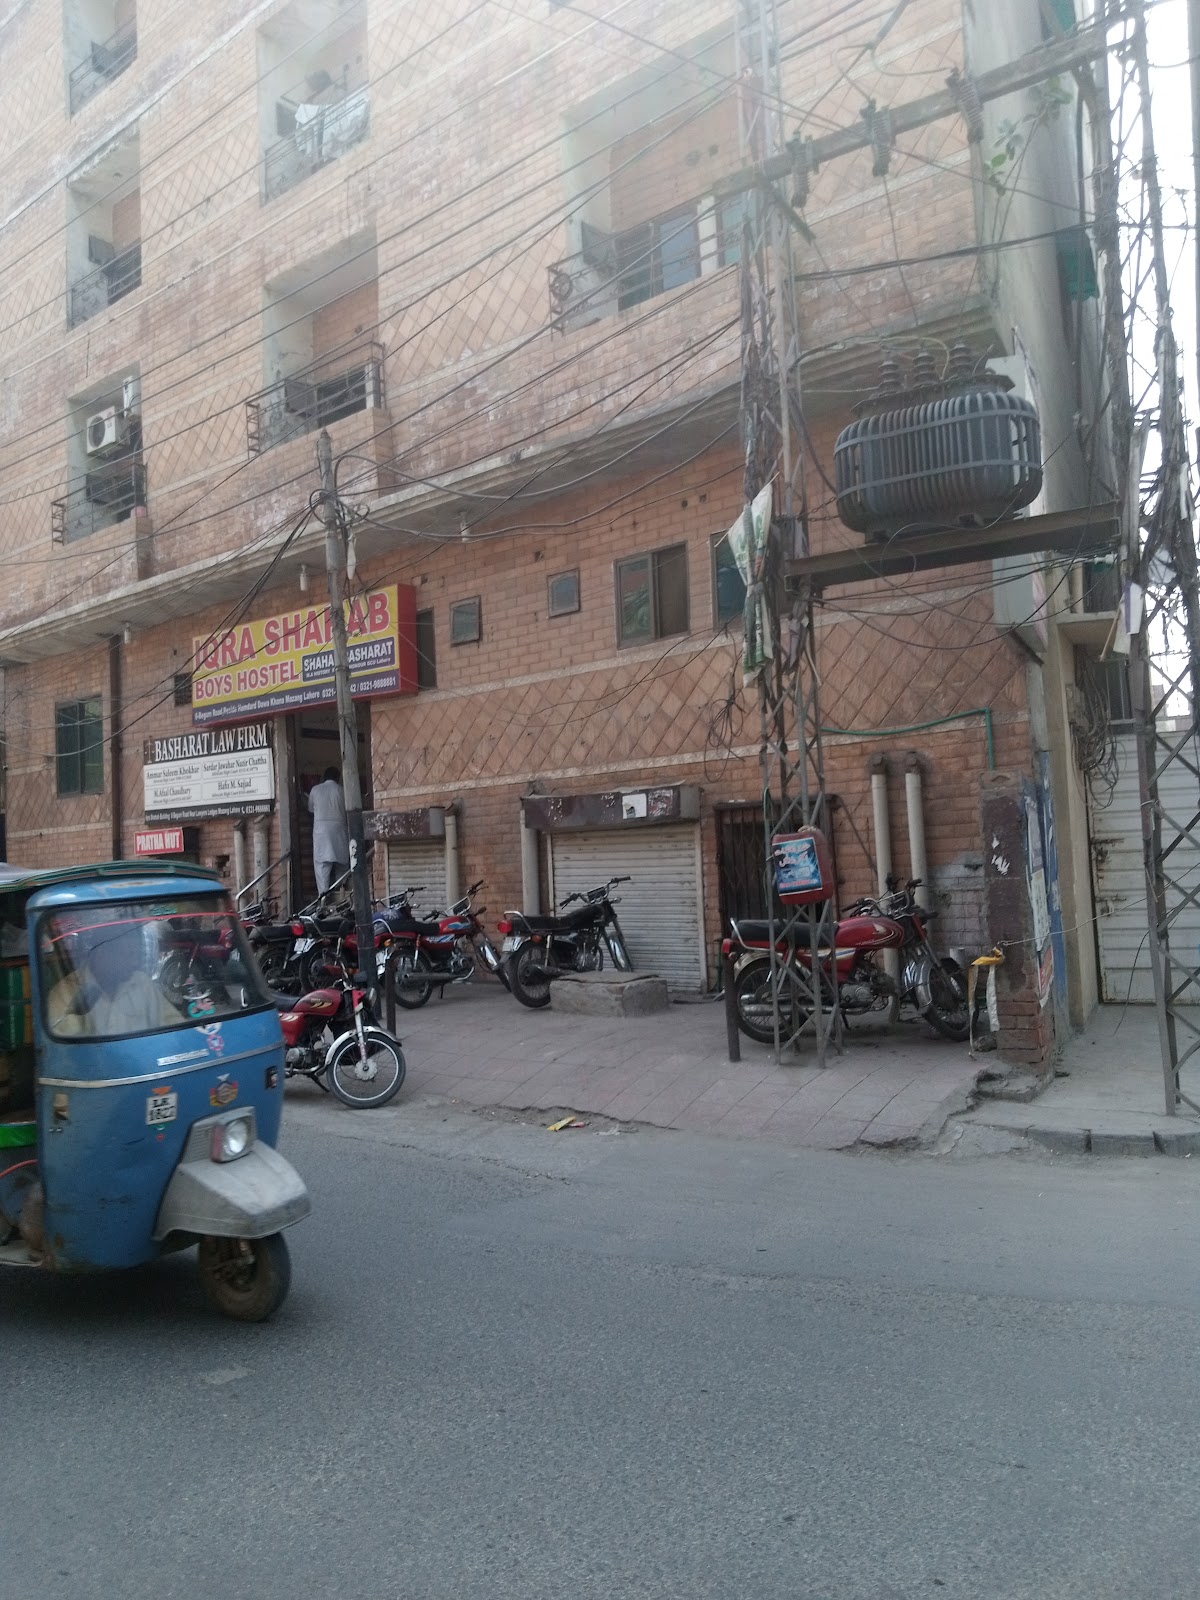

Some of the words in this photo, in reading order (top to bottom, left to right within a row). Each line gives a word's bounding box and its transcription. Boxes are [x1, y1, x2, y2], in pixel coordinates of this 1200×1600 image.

[194, 626, 257, 671] IQRA
[347, 641, 392, 662] ASHARAT
[196, 674, 233, 700] BOYS
[237, 661, 299, 692] HOSTEL
[303, 690, 320, 700] Lahore
[154, 732, 210, 762] BASHARAT
[211, 728, 236, 754] LAW
[237, 723, 268, 750] FIRM
[136, 833, 164, 851] PRATHA
[165, 831, 180, 849] HUT
